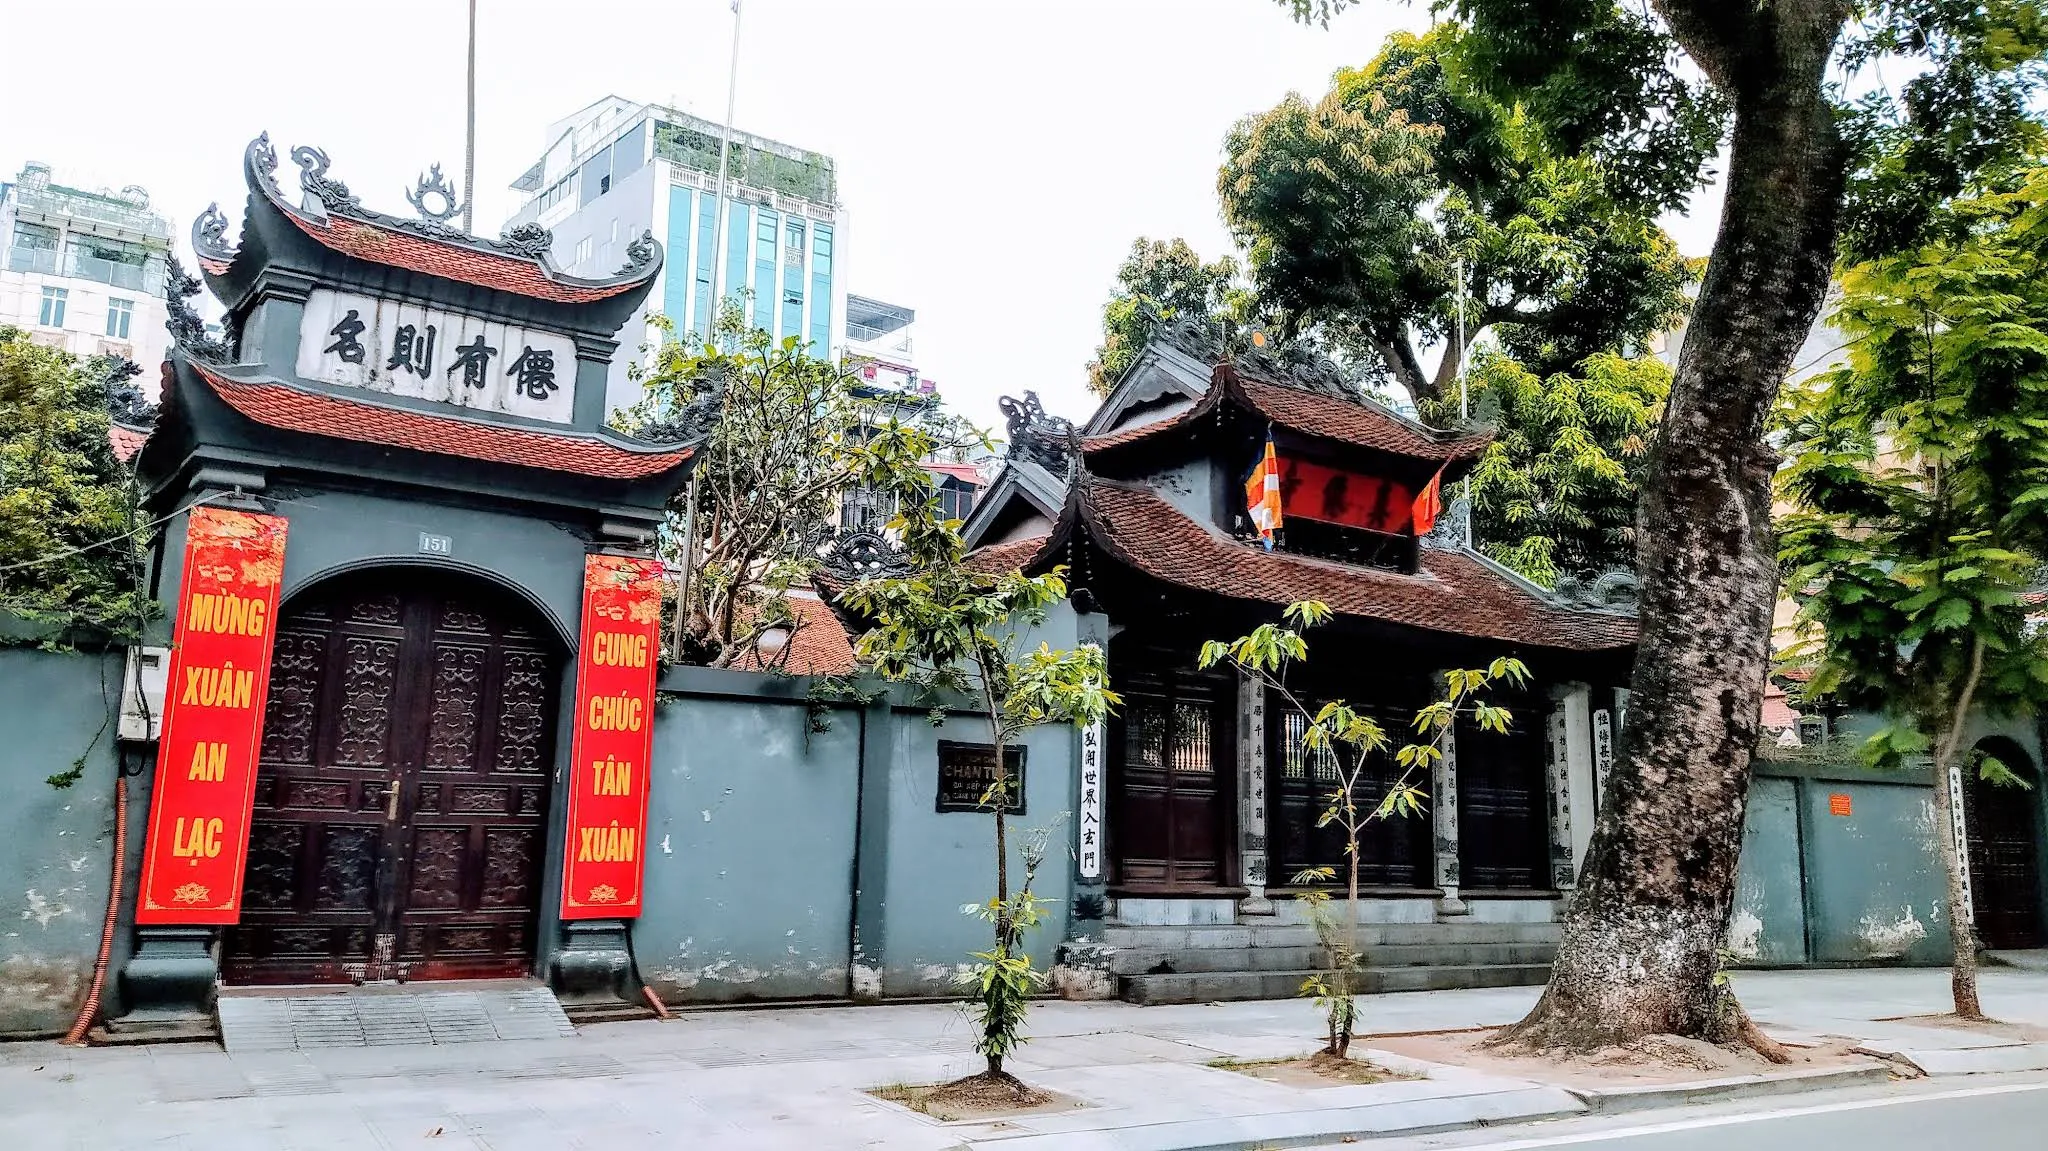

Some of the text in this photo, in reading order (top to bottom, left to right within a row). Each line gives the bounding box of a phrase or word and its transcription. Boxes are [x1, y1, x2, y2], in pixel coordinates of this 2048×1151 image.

[423, 537, 447, 552] 151
[189, 588, 265, 637] MỪNG
[592, 631, 647, 668] CUNG
[181, 661, 254, 709] XUÂN
[588, 690, 642, 732] CHÚC
[188, 741, 228, 783] AN
[592, 754, 632, 796] TÂN
[172, 816, 224, 866] LẠC
[577, 820, 636, 862] XUÂN
